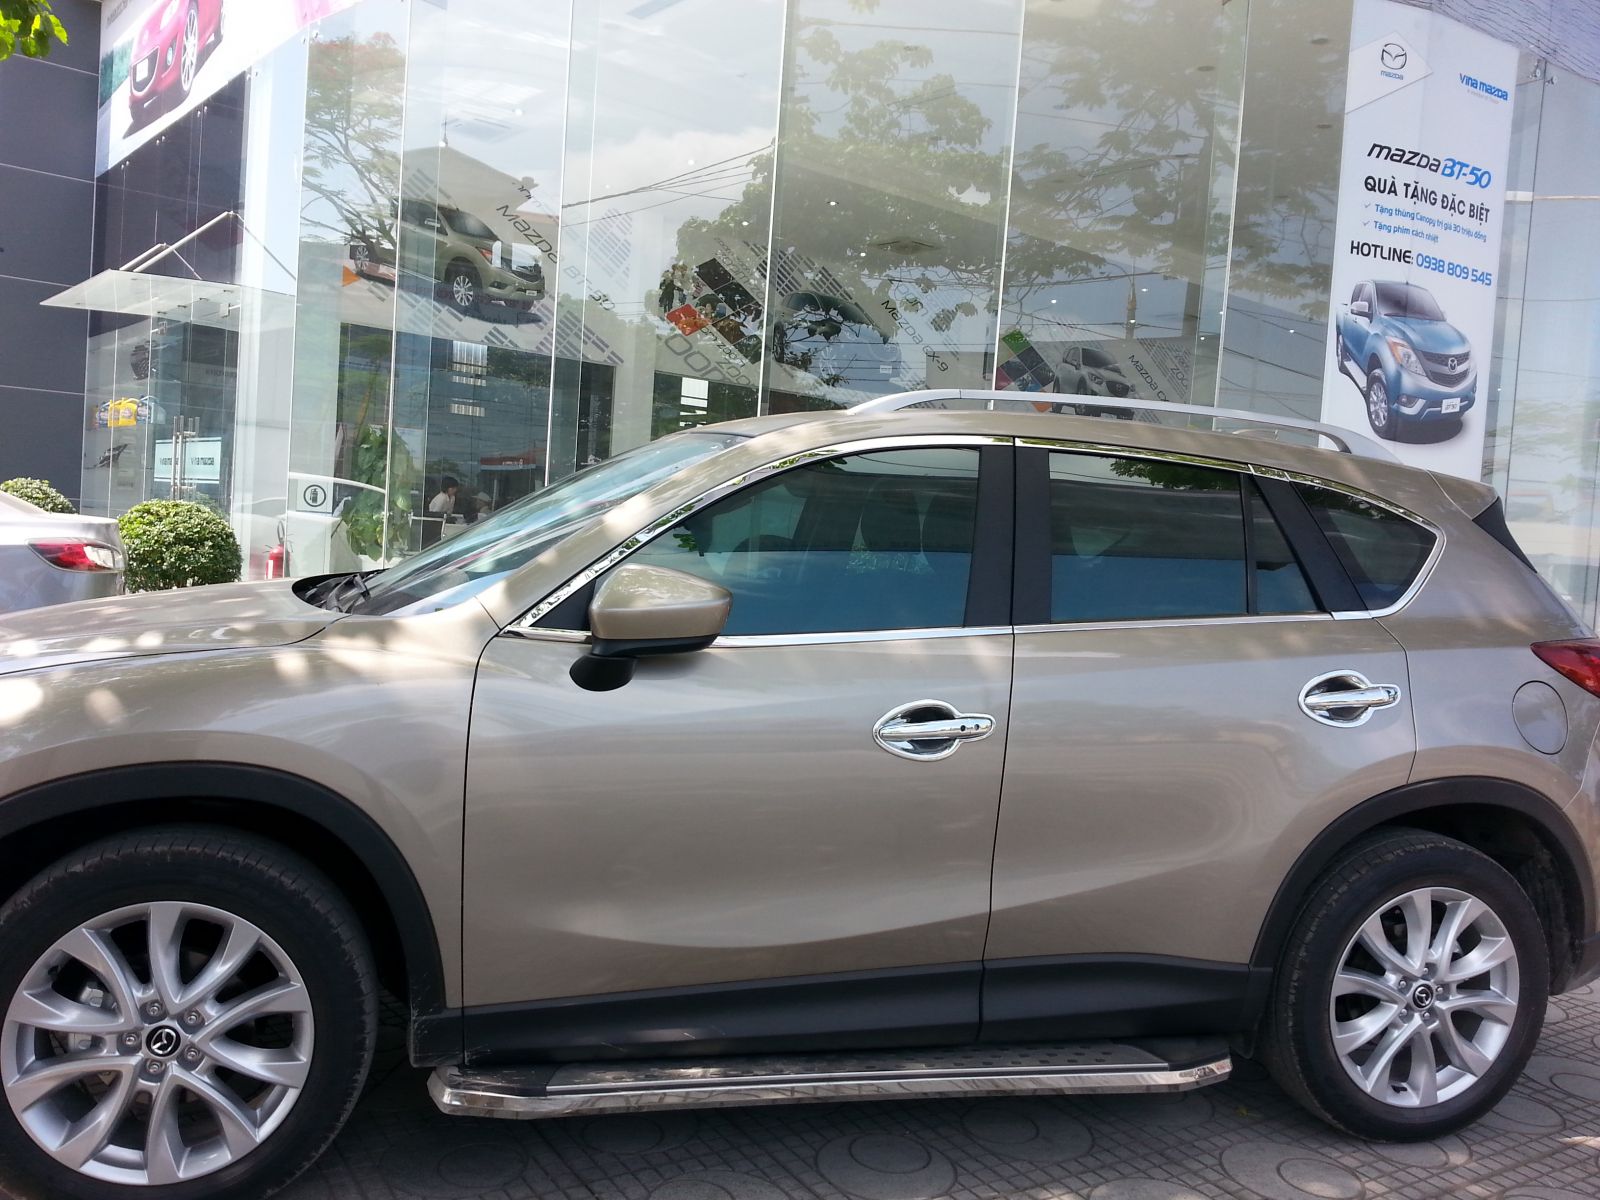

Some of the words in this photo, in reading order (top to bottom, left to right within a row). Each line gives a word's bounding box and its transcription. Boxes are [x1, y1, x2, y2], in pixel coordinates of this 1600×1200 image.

[1479, 81, 1508, 100] mazda
[1367, 143, 1442, 173] mazda
[1441, 157, 1492, 189] BT-50
[1364, 175, 1398, 197] QUÀ
[1403, 180, 1438, 206] TẶNG
[1441, 193, 1466, 217] ĐẶC
[1468, 202, 1490, 226] BIỆT
[1375, 203, 1393, 217] Tặng
[1394, 207, 1415, 221] thùng
[1416, 212, 1436, 227] Canopy
[1453, 223, 1461, 233] 30
[496, 204, 560, 264] Mazda
[1374, 220, 1392, 233] Tặng
[1393, 224, 1411, 236] phim
[1350, 240, 1414, 265] HOTLINE:
[1416, 252, 1446, 274] 0938
[1447, 261, 1470, 280] 809
[1471, 268, 1492, 287] 545
[1128, 354, 1159, 391] Mazda
